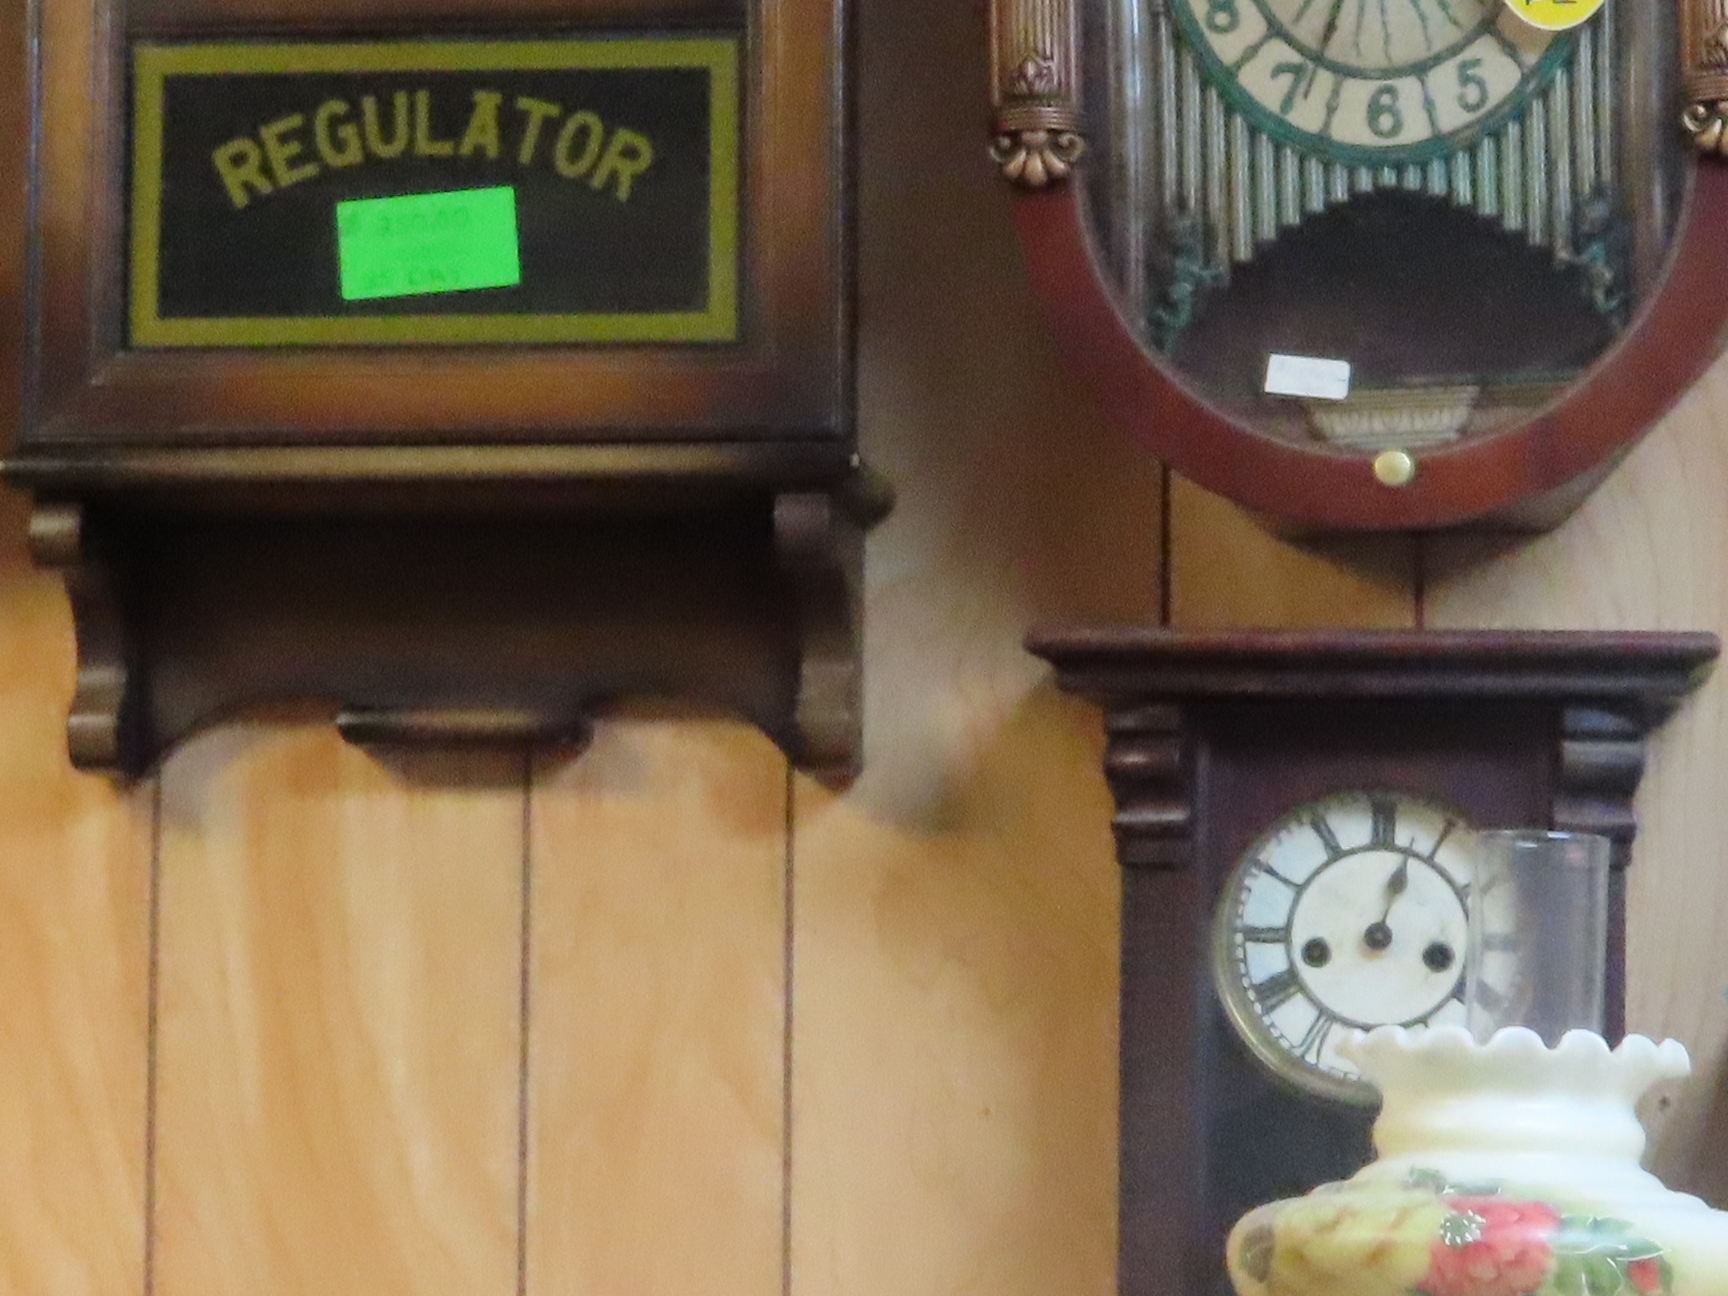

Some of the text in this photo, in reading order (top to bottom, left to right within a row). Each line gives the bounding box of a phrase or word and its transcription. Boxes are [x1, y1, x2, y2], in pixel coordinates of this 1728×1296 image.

[1366, 85, 1403, 138] 6
[1455, 59, 1490, 111] 5
[211, 89, 654, 210] REGULATOR
